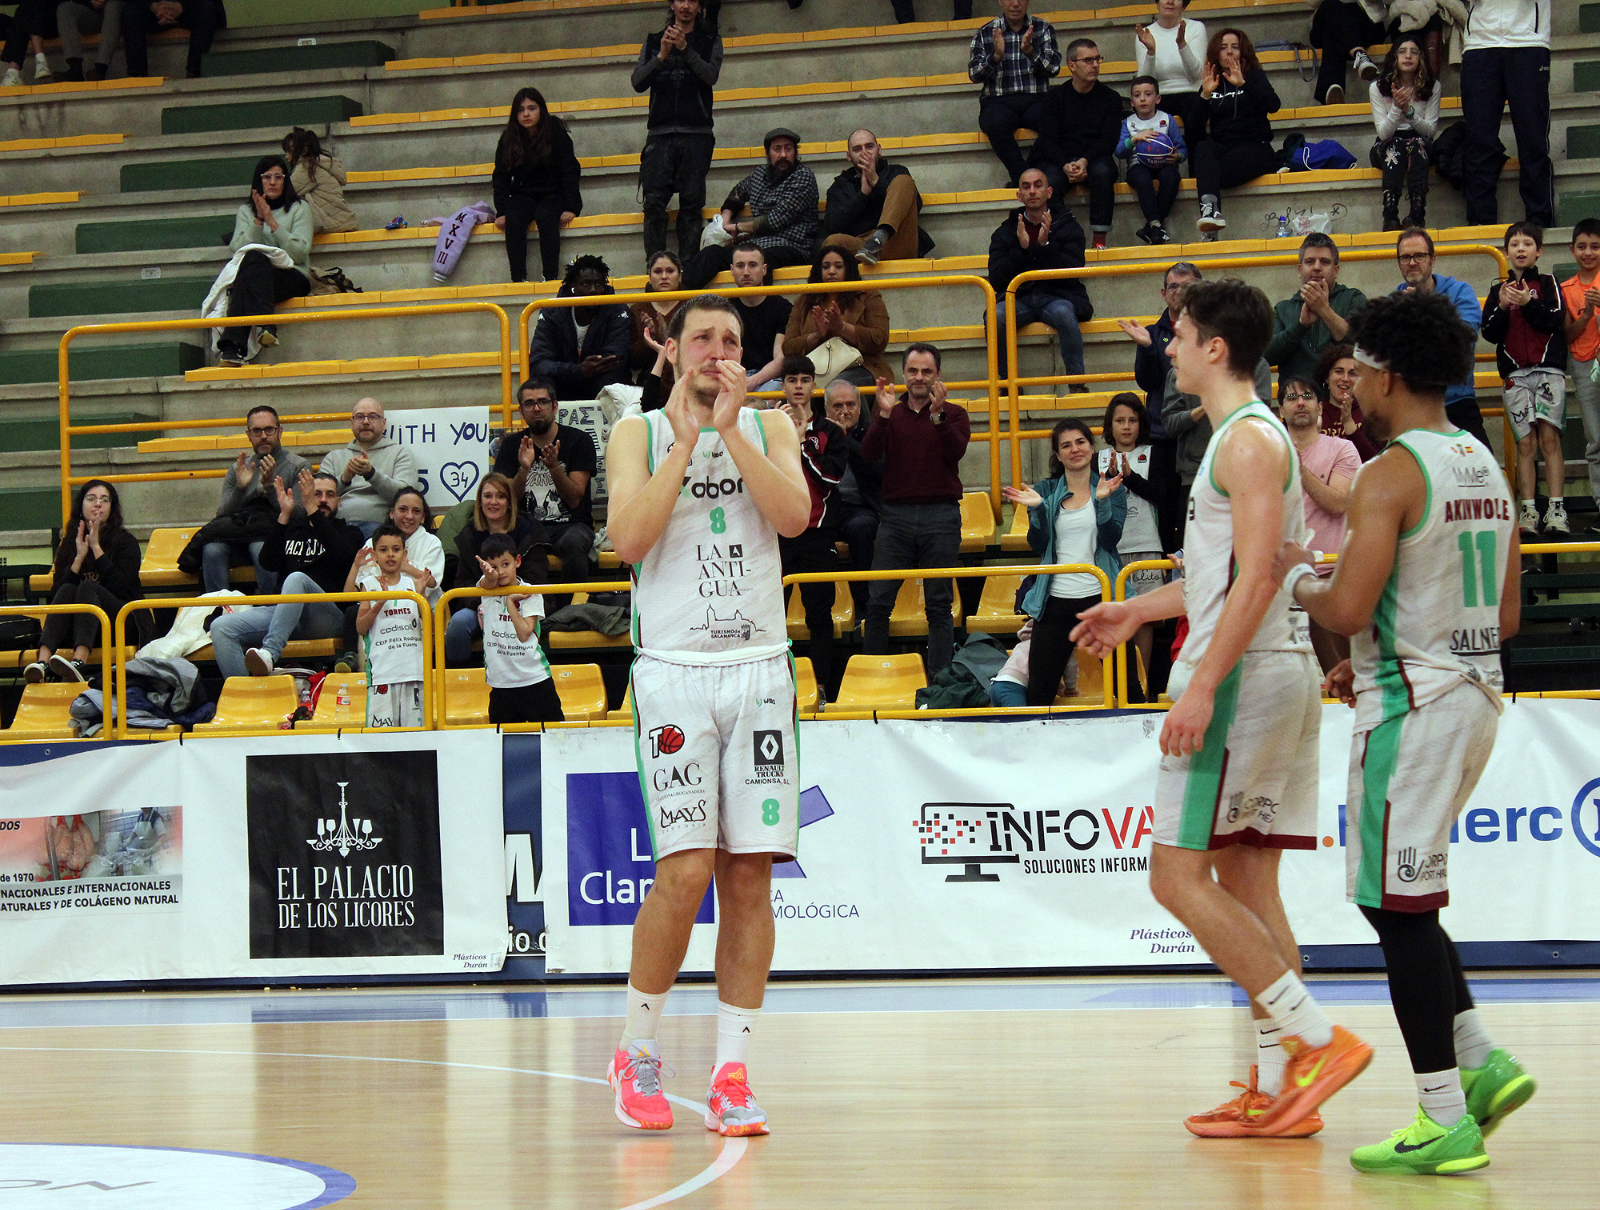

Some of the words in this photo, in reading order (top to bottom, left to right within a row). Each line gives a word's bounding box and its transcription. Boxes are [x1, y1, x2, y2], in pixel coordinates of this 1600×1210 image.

[450, 421, 487, 446] YOU
[450, 471, 469, 489] 34
[709, 506, 727, 534] 8
[695, 543, 722, 562] LA
[1458, 530, 1497, 608] 11
[698, 579, 743, 599] GUA
[653, 762, 703, 792] GAG
[660, 799, 707, 829] MAYS
[762, 798, 780, 826] 8
[1024, 858, 1096, 875] SOLUCIONES
[1, 873, 11, 883] de
[13, 873, 35, 883] 1970
[277, 867, 305, 900] EL
[313, 864, 414, 900] PALACIO
[0, 886, 66, 899] NACIONALES
[67, 886, 73, 895] E
[74, 880, 171, 894] INTERNACIONALES
[53, 901, 60, 910] Y
[60, 900, 72, 908] DE
[75, 895, 131, 908] COLÁGENO
[134, 895, 179, 905] NATURAL
[278, 904, 301, 929] DE
[307, 903, 337, 928] LOS
[343, 901, 415, 928] LICORES
[1130, 927, 1193, 940] Plásticos
[453, 953, 487, 961] Plásticos
[1149, 941, 1195, 954] Durán
